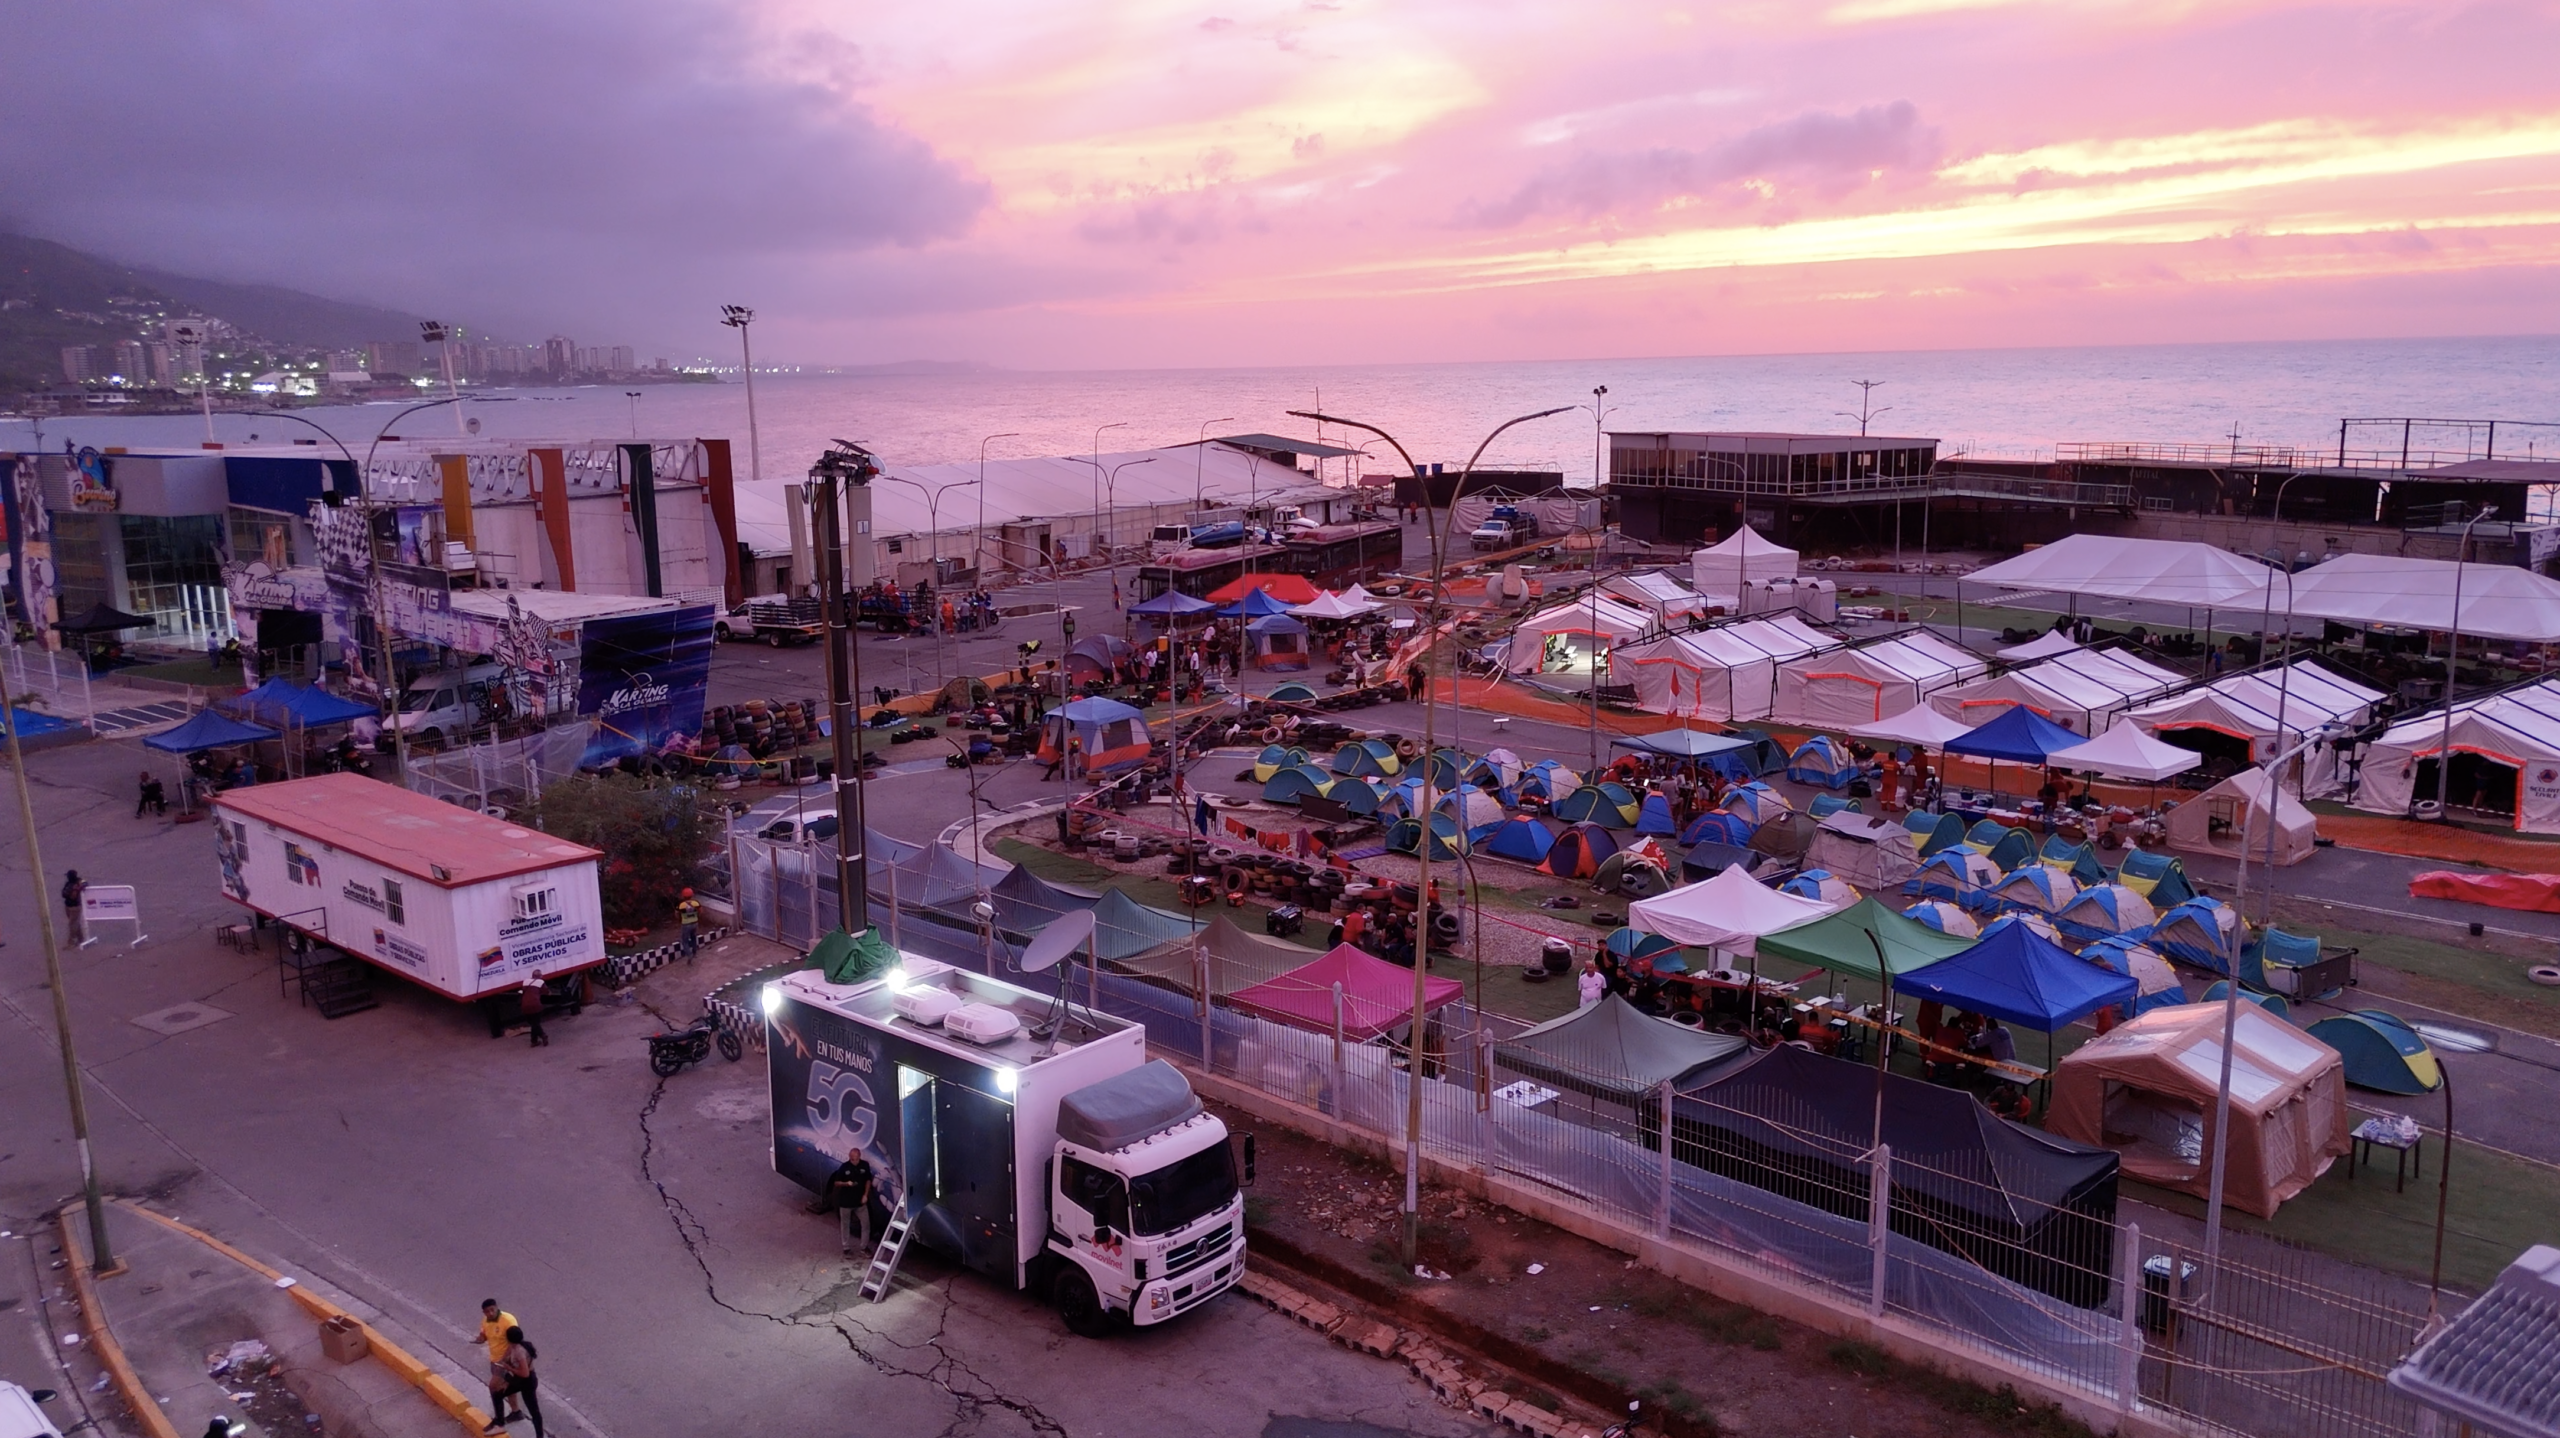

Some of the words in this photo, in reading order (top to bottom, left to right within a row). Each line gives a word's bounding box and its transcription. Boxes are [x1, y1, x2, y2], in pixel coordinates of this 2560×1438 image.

[609, 684, 669, 708] KARTING
[500, 921, 539, 936] Comando
[540, 914, 563, 927] Móvil
[512, 944, 543, 958] OBRAS
[544, 932, 587, 950] PÚBLICAS
[522, 947, 567, 965] SERVICIOS
[812, 1017, 824, 1039] EL
[827, 1022, 869, 1055] FUTURO
[817, 1040, 828, 1057] EN
[829, 1044, 844, 1063] TUS
[845, 1050, 873, 1074] MANOS
[806, 1060, 878, 1150] 5G
[1091, 1251, 1123, 1270] movilnet
